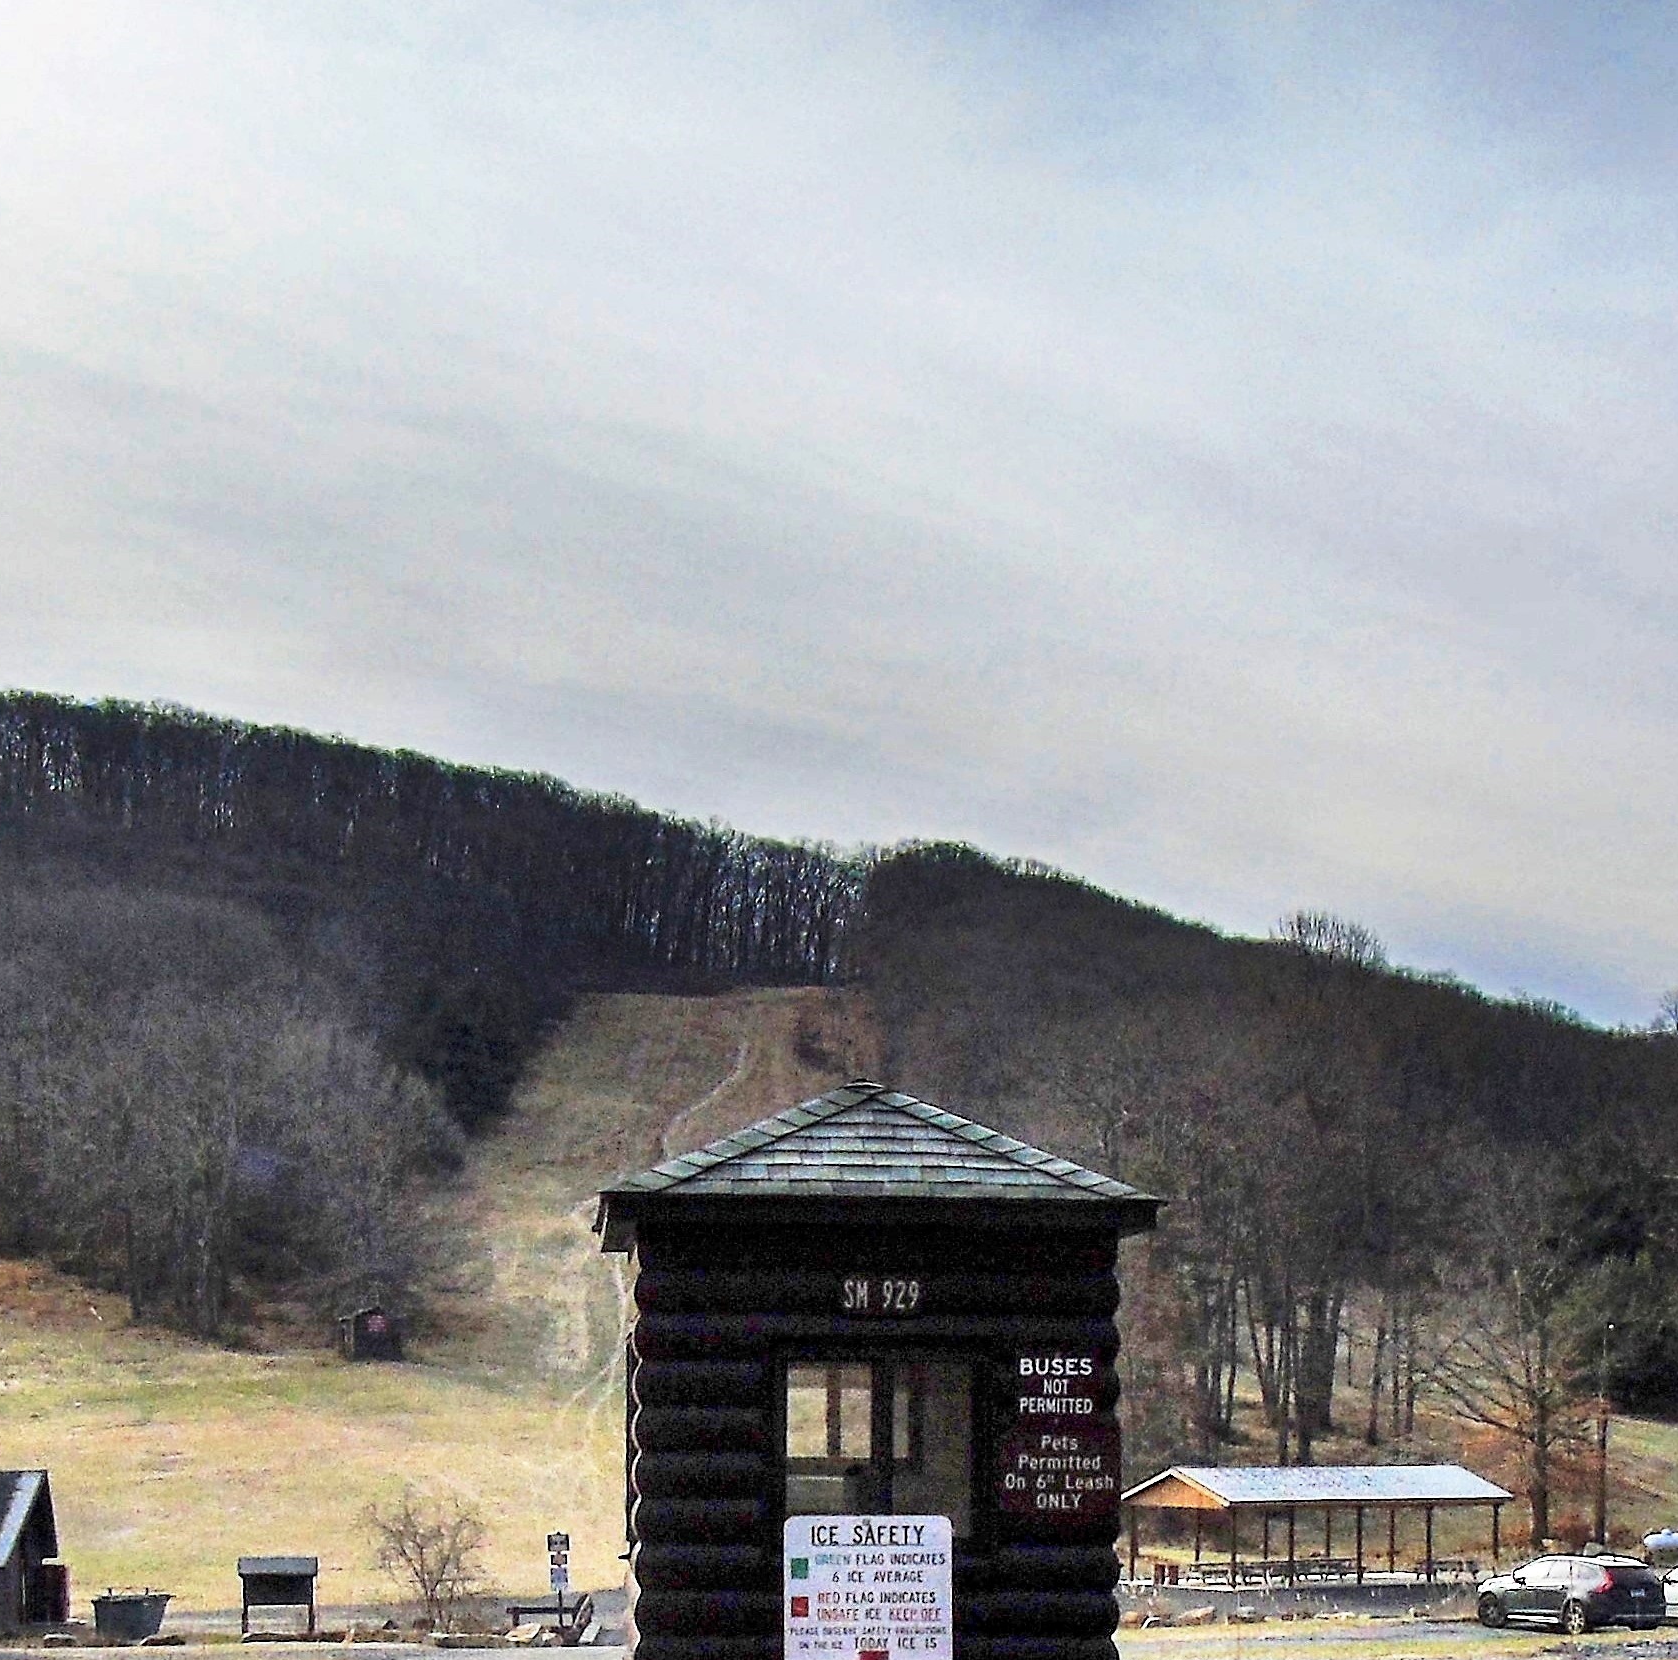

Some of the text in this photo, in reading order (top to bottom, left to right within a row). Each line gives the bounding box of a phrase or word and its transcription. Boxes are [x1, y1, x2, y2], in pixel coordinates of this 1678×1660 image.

[883, 1281, 919, 1309] 929
[1019, 1358, 1093, 1376] BUSES
[1043, 1379, 1069, 1395] NOT
[1019, 1397, 1093, 1414] PERMITTED
[1041, 1435, 1079, 1450] Pets
[1018, 1454, 1101, 1470] Permitted
[1004, 1473, 1026, 1489] On
[1065, 1474, 1114, 1489] Leash
[1036, 1493, 1082, 1509] ONLY
[811, 1525, 925, 1545] ICE SAFETY
[815, 1553, 946, 1565] GREEN FLAG INDICATES
[832, 1571, 924, 1583] 6 ICE AVERAGE
[817, 1591, 936, 1604] RED FLAG INDICATES
[817, 1608, 860, 1620] UNSAFE
[865, 1608, 882, 1620] ICE
[889, 1608, 918, 1620] KEEP
[855, 1637, 888, 1649] TODAY
[897, 1637, 916, 1649] ICE
[925, 1637, 938, 1649] IS
